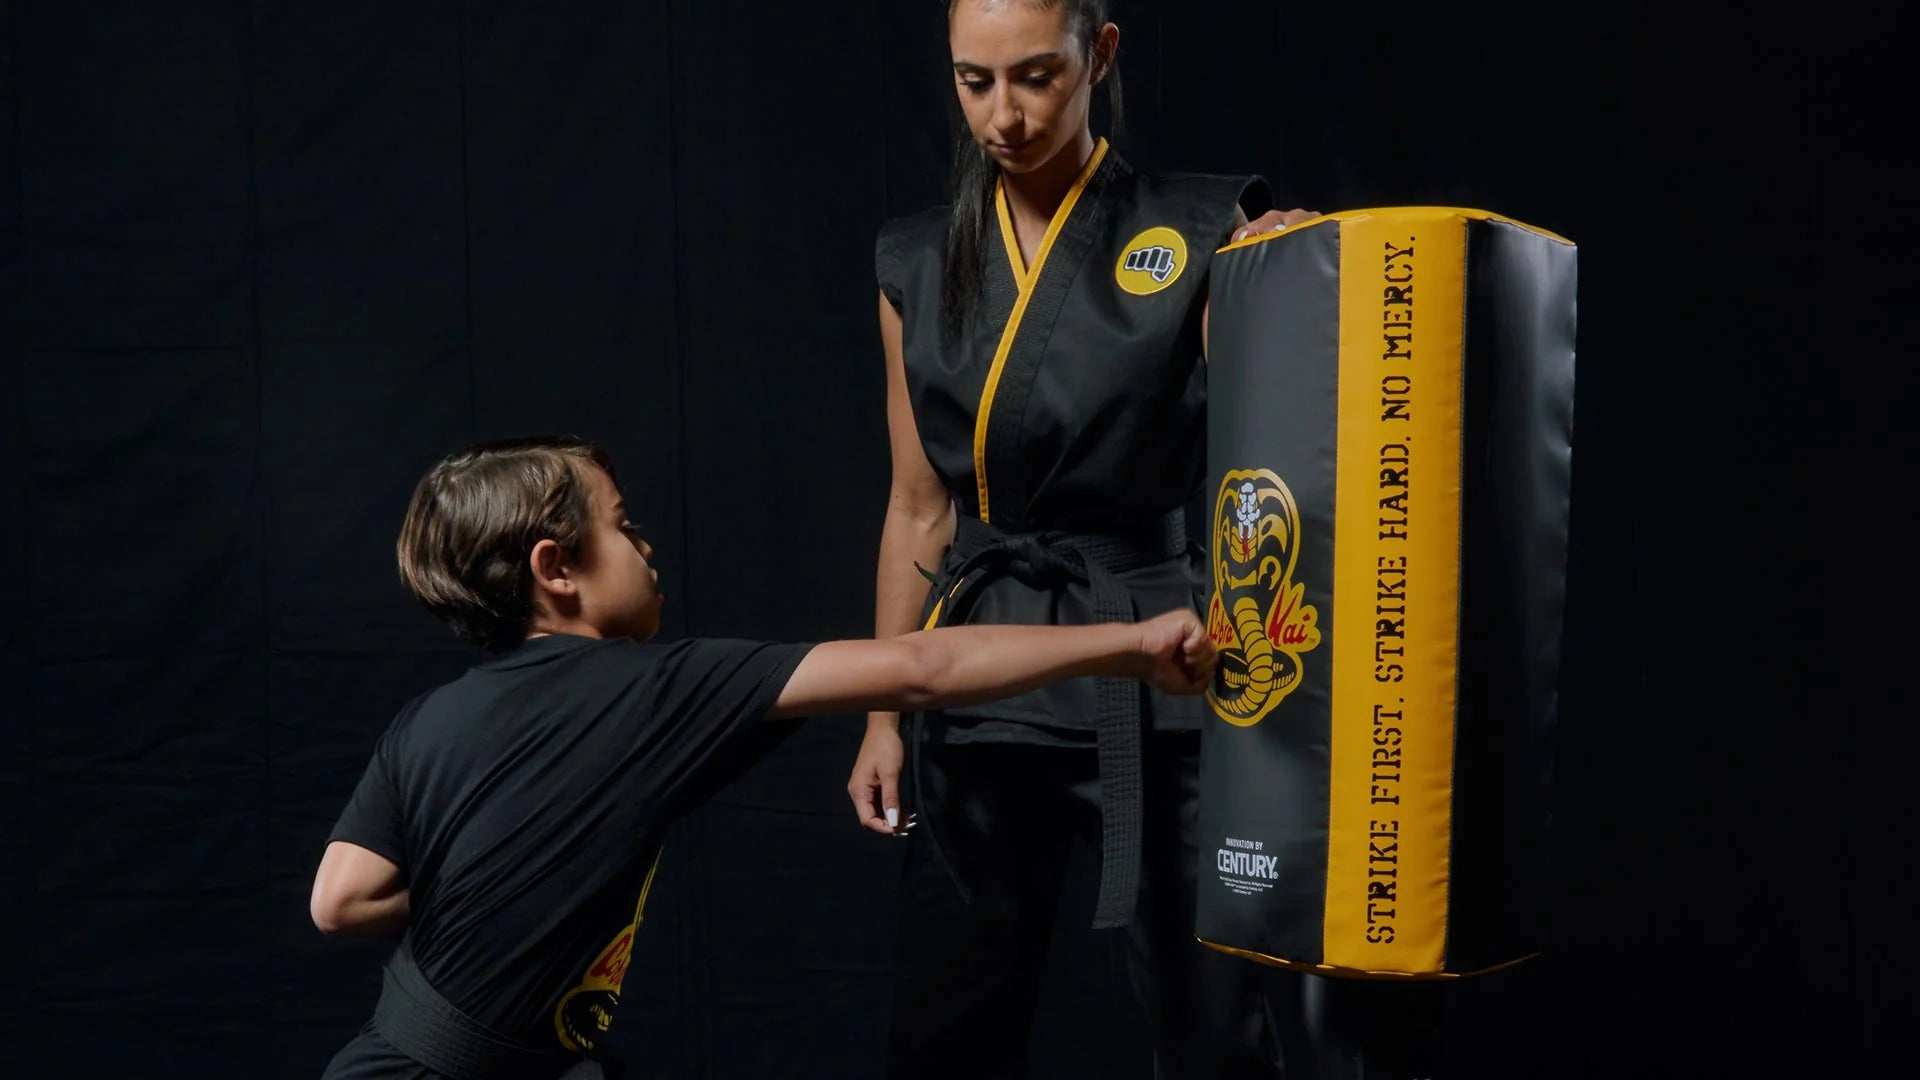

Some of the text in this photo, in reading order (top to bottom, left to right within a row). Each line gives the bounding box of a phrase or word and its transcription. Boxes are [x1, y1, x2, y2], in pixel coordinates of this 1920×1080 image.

[1267, 583, 1311, 647] Kai
[1366, 235, 1416, 944] STRIKE FIRST. STRIKE HARD. NO MERCY.
[1225, 837, 1264, 851] INNOVATION BY
